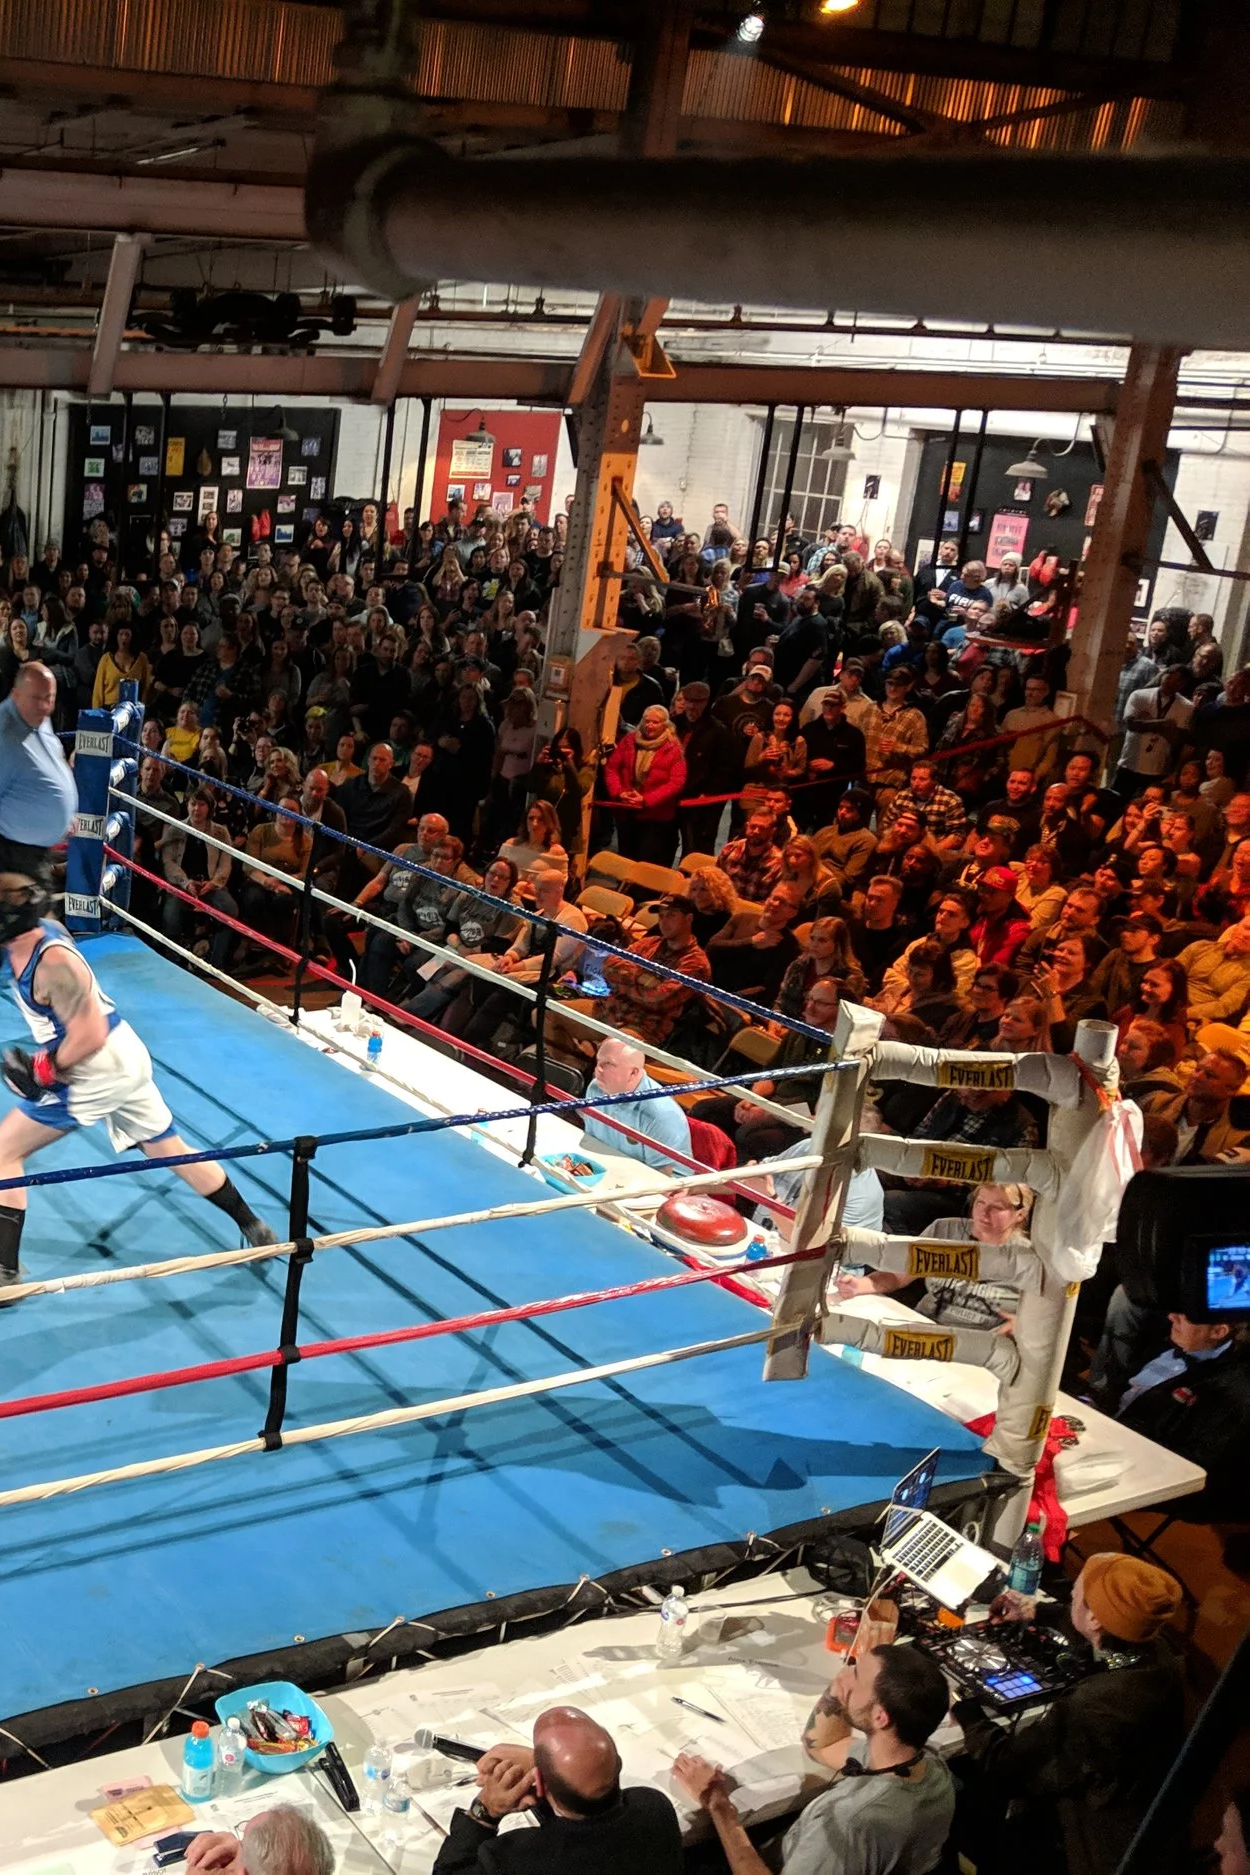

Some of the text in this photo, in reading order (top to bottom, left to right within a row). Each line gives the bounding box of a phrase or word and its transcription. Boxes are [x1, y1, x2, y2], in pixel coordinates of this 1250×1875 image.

[949, 593, 975, 608] FIR
[78, 733, 109, 753] EVERLAST
[77, 816, 104, 836] ERLAST
[68, 896, 99, 916] EVERLAST
[950, 1065, 1012, 1088] EVERLAST
[931, 1152, 991, 1182] EVERLAST
[915, 1247, 975, 1277] EVERLAST
[892, 1332, 949, 1361] EVERLAST
